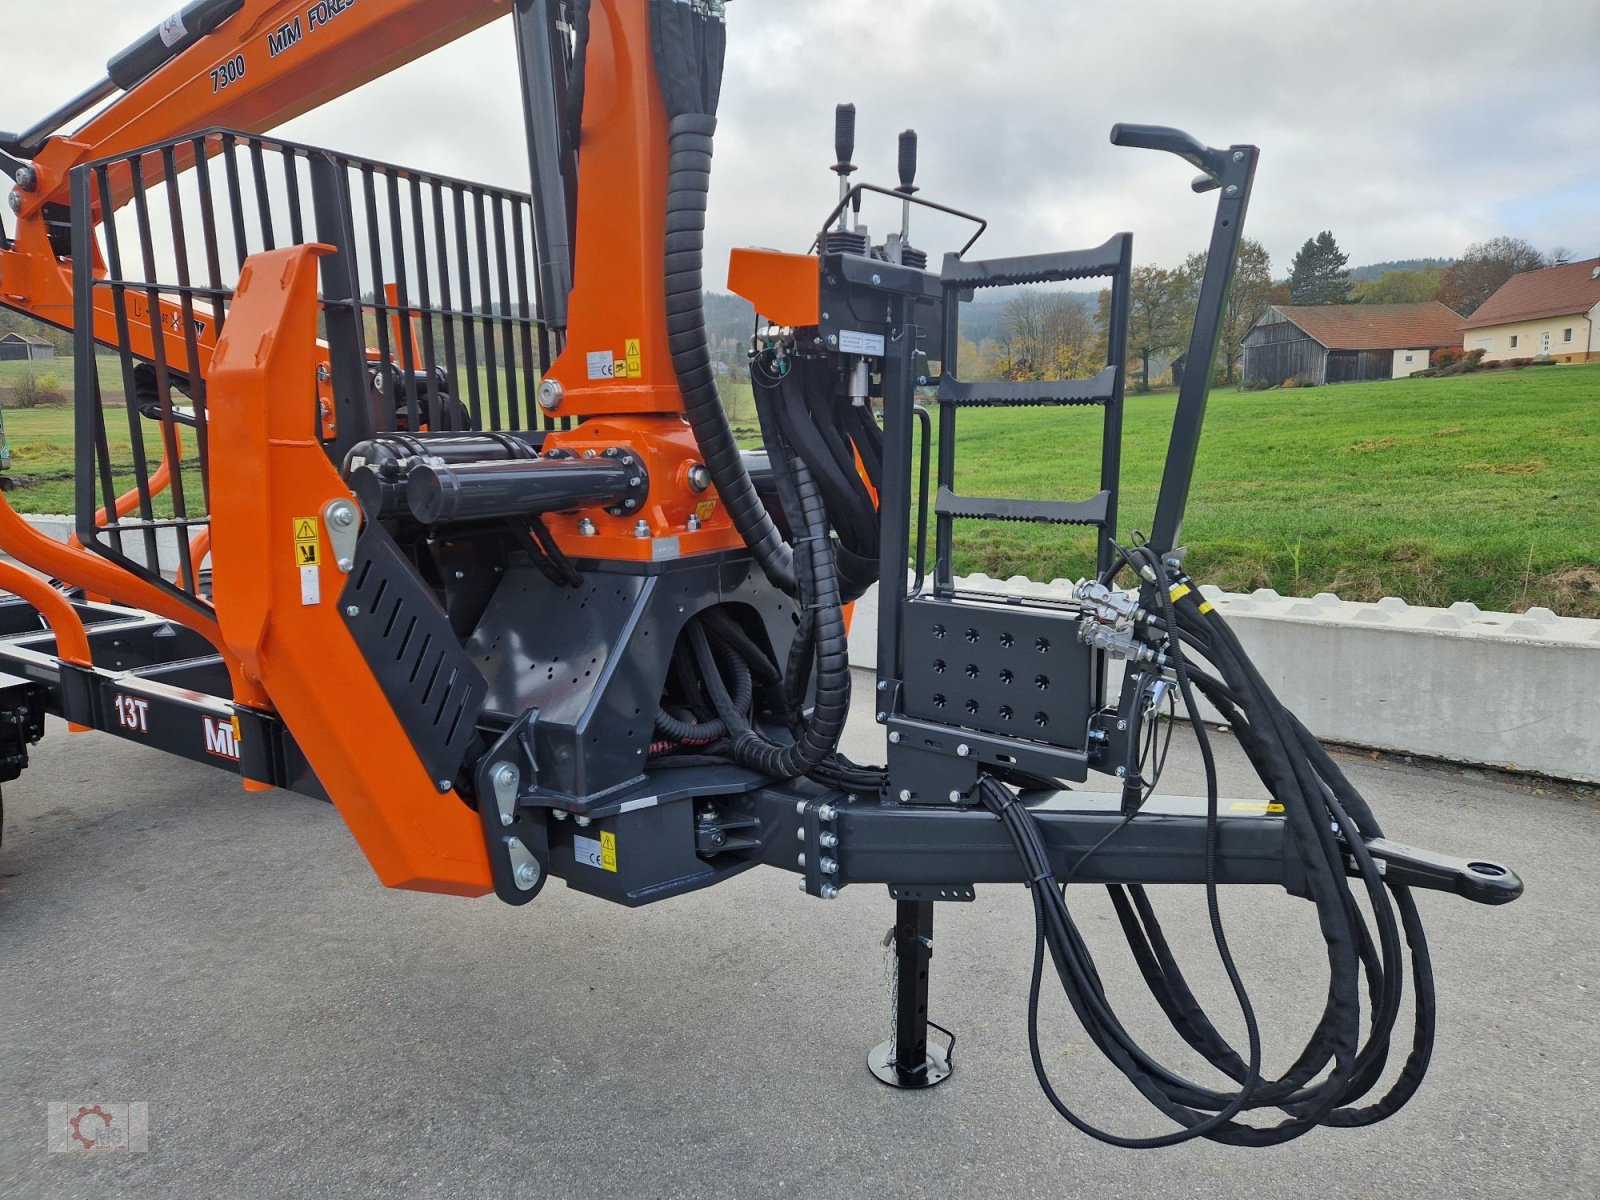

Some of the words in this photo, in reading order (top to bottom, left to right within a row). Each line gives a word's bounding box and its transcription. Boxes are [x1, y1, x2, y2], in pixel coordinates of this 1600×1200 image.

[267, 14, 303, 58] MTM
[210, 54, 245, 94] 7300
[115, 693, 148, 733] 13T
[202, 715, 240, 761] MT
